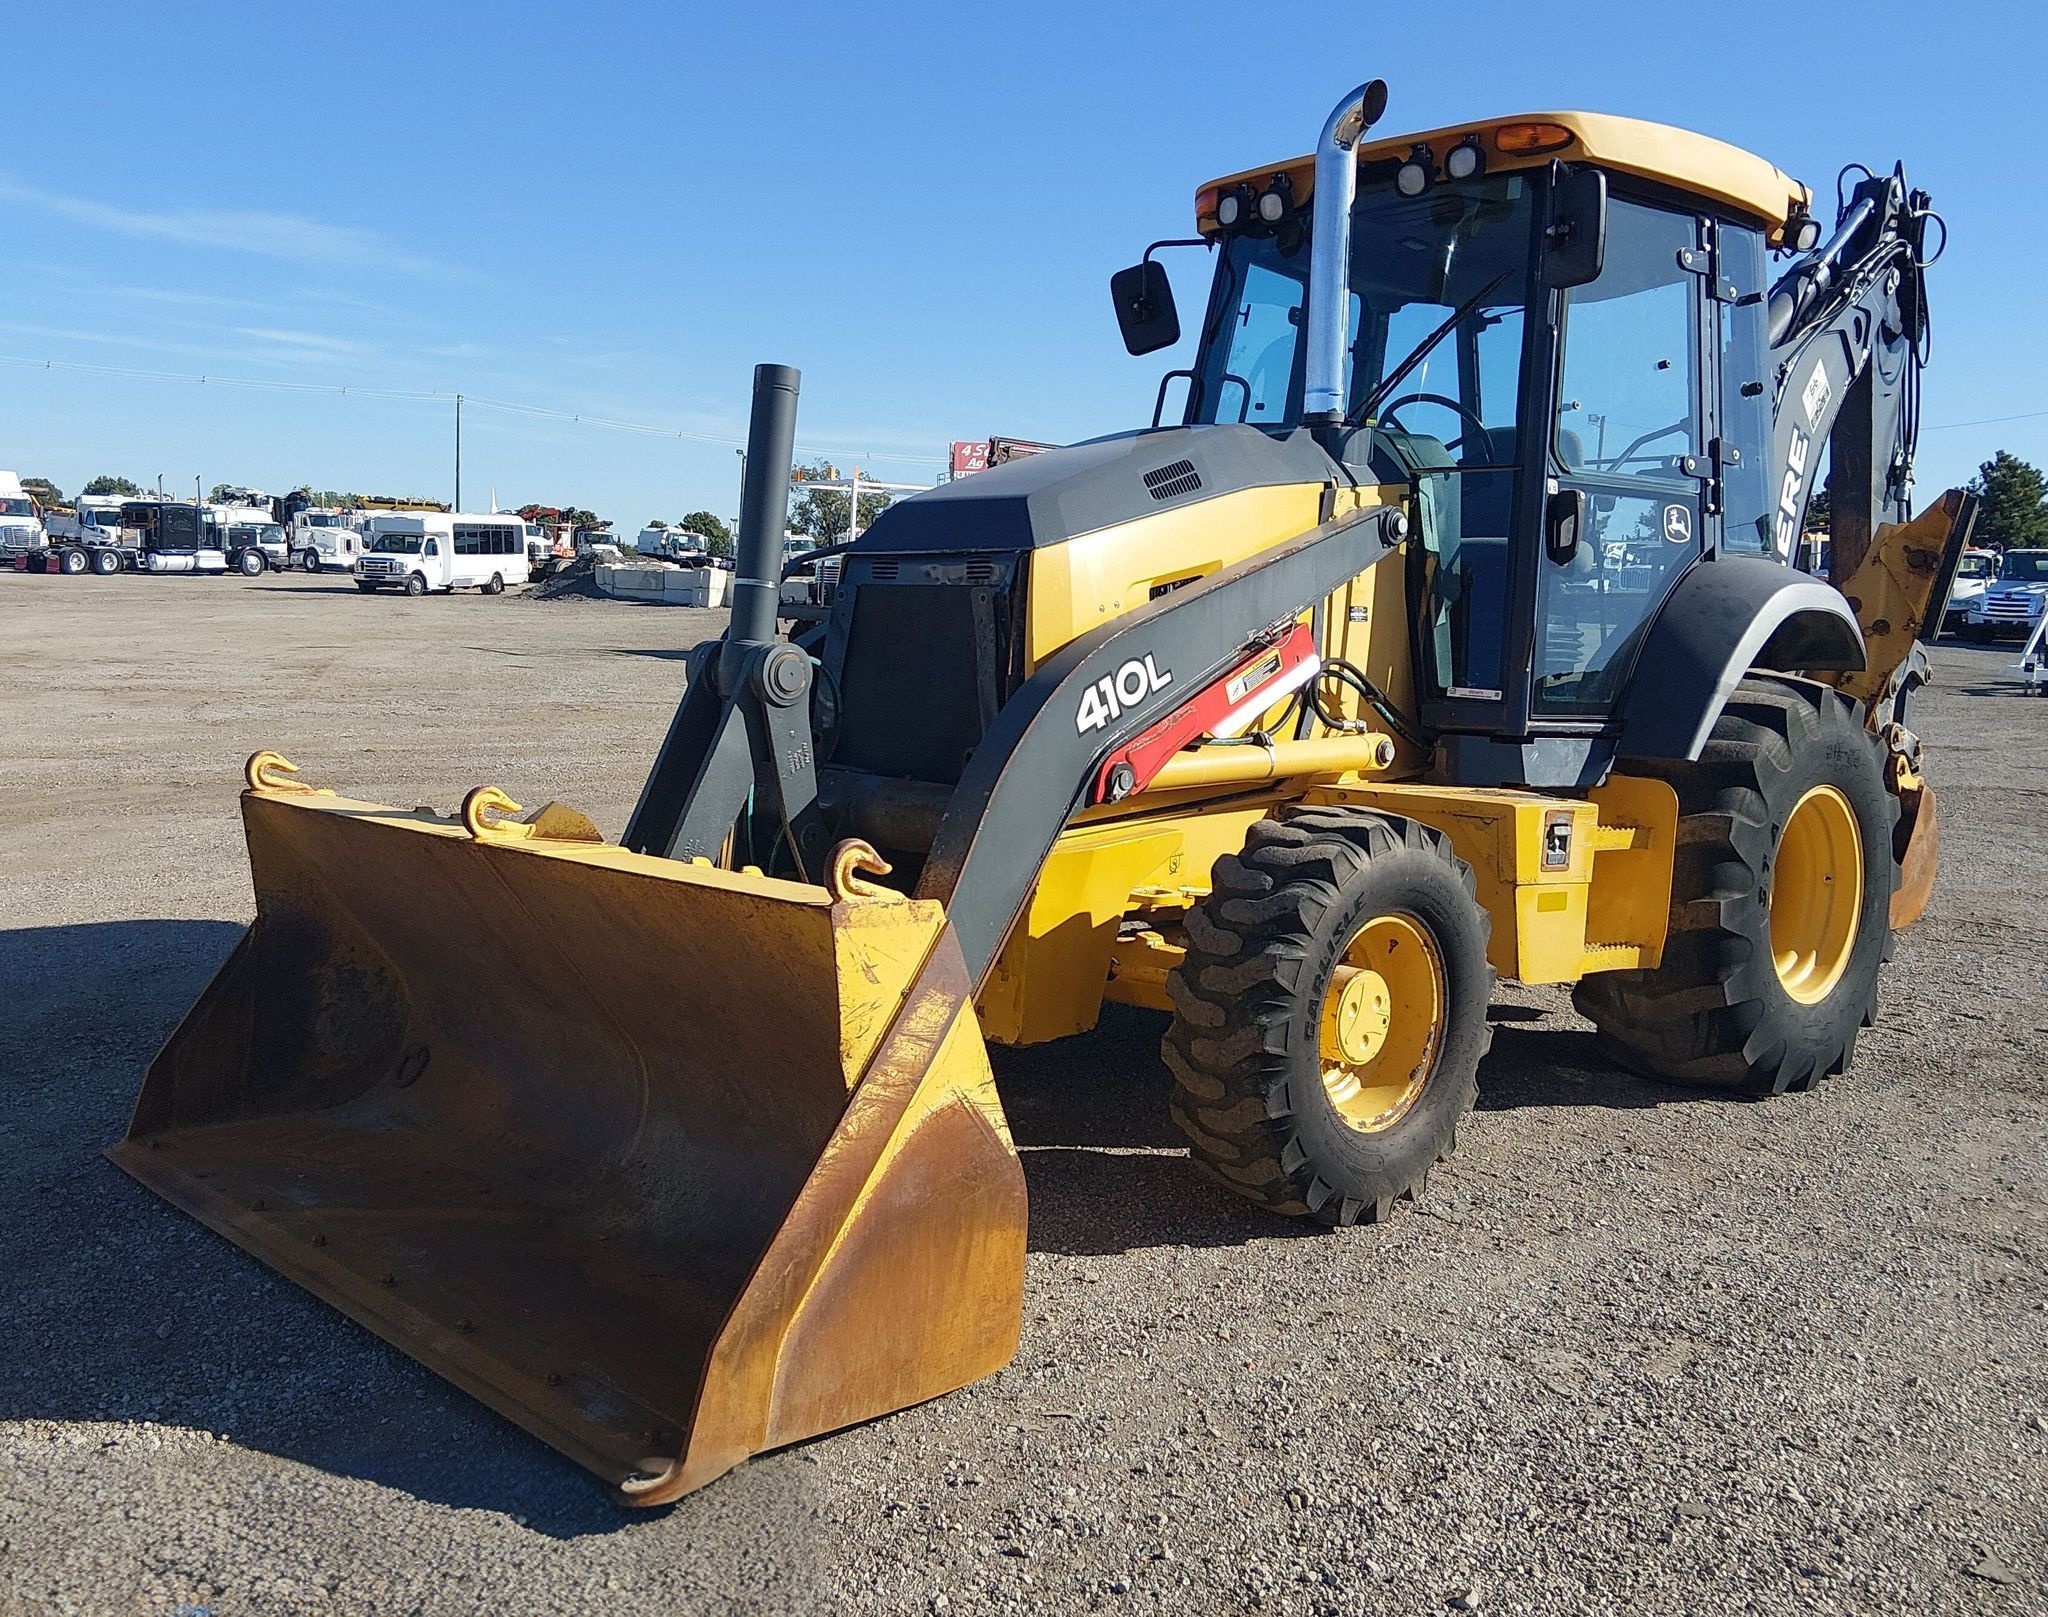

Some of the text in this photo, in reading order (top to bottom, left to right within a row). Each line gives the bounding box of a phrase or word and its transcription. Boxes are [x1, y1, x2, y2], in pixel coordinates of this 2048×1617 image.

[961, 444, 972, 457] 4
[965, 457, 985, 469] Ag
[1777, 427, 1809, 566] ERE
[1075, 652, 1173, 736] 410L
[1303, 891, 1367, 1042] CARLISLE
